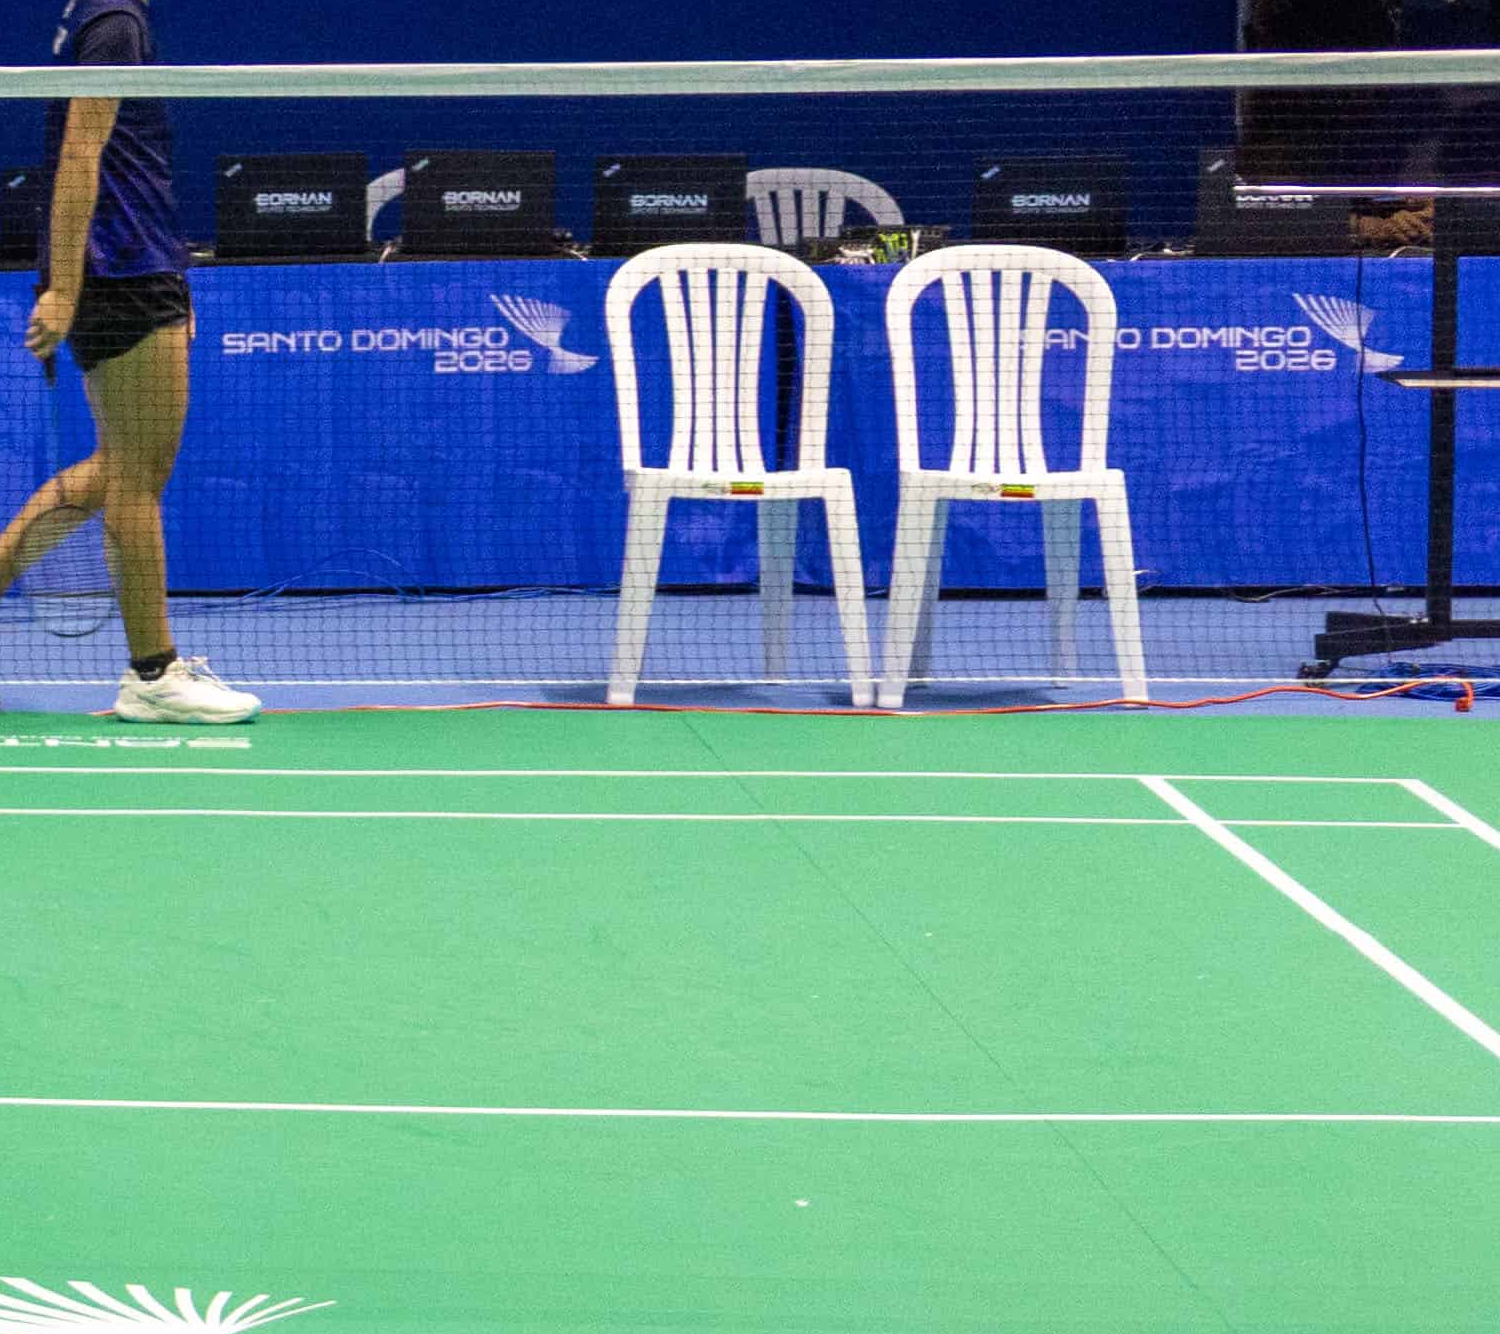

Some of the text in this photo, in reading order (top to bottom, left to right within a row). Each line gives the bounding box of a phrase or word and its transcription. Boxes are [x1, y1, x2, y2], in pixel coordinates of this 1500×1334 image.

[442, 191, 522, 205] BORNAN
[1011, 194, 1090, 207] BORNAN
[222, 327, 509, 354] SANTO DOMINGO
[1019, 326, 1312, 350] ANO DOMINGO
[433, 350, 533, 373] 2026
[1235, 348, 1337, 371] 2026
